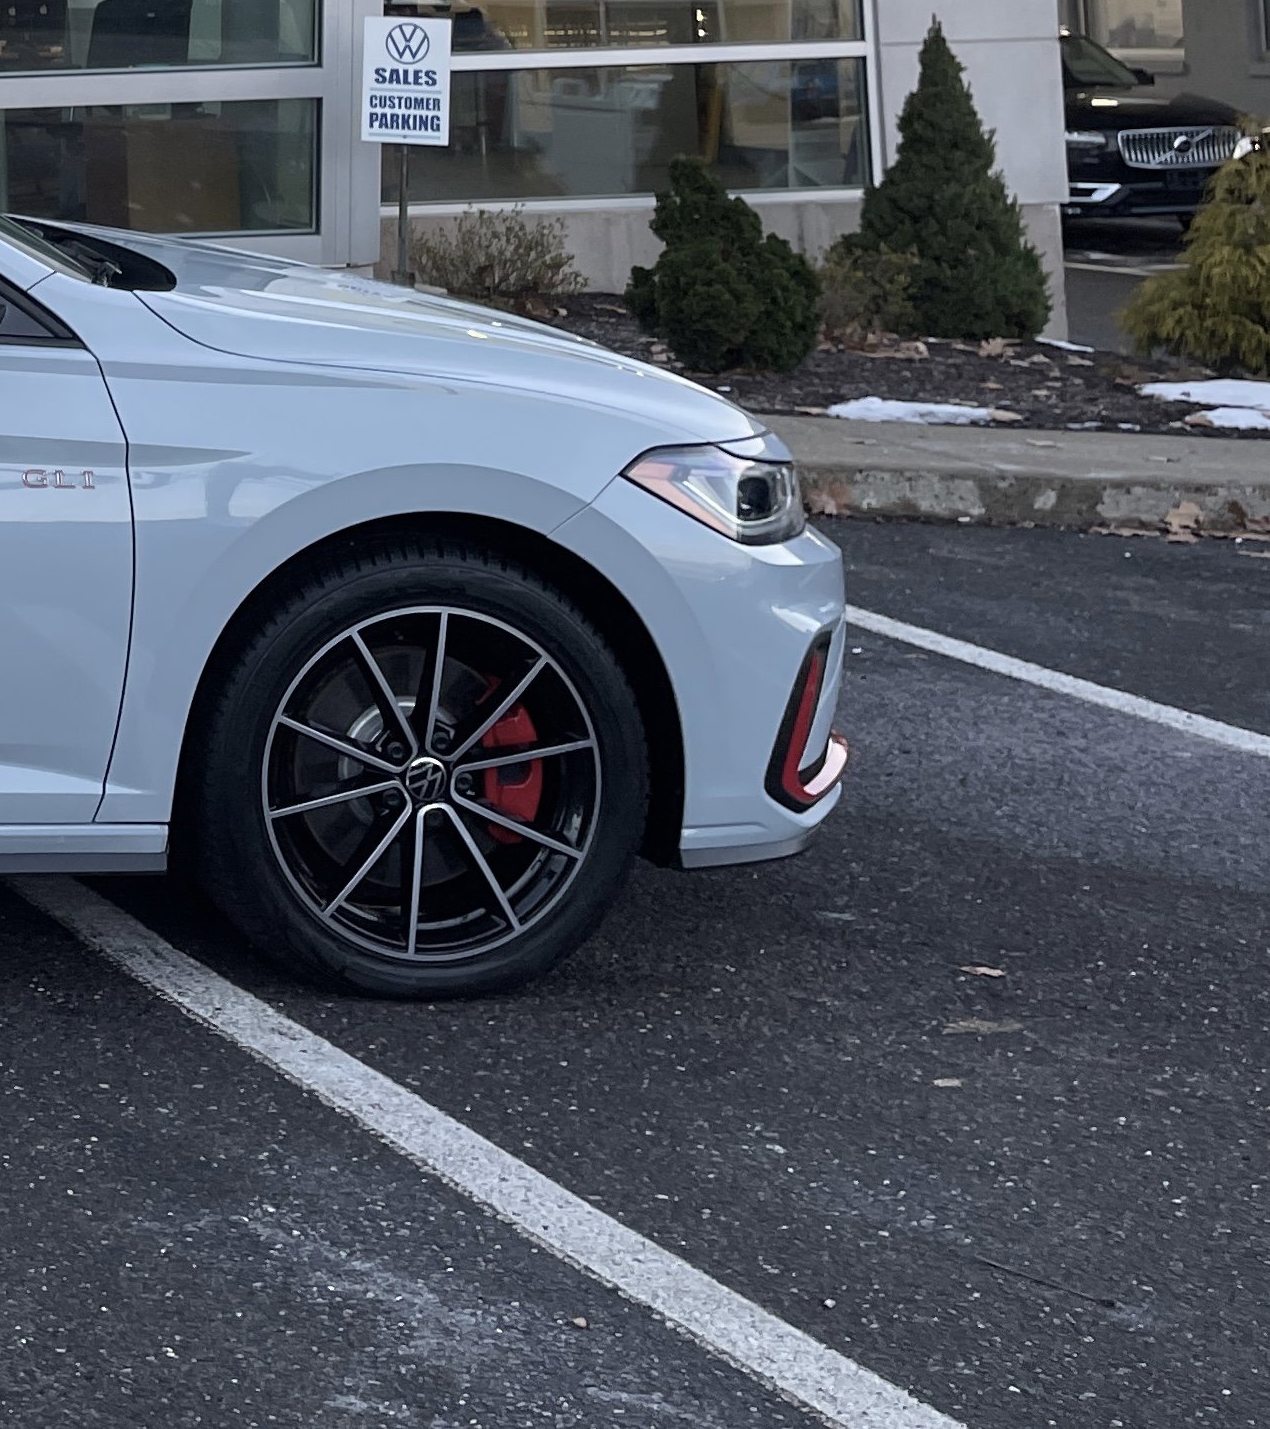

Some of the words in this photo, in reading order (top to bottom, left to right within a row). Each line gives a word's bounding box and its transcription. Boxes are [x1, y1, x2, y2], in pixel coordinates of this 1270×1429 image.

[374, 68, 437, 86] SALES
[370, 95, 441, 112] CUSTOMER
[369, 112, 441, 132] PARKING
[22, 468, 96, 489] GLI
